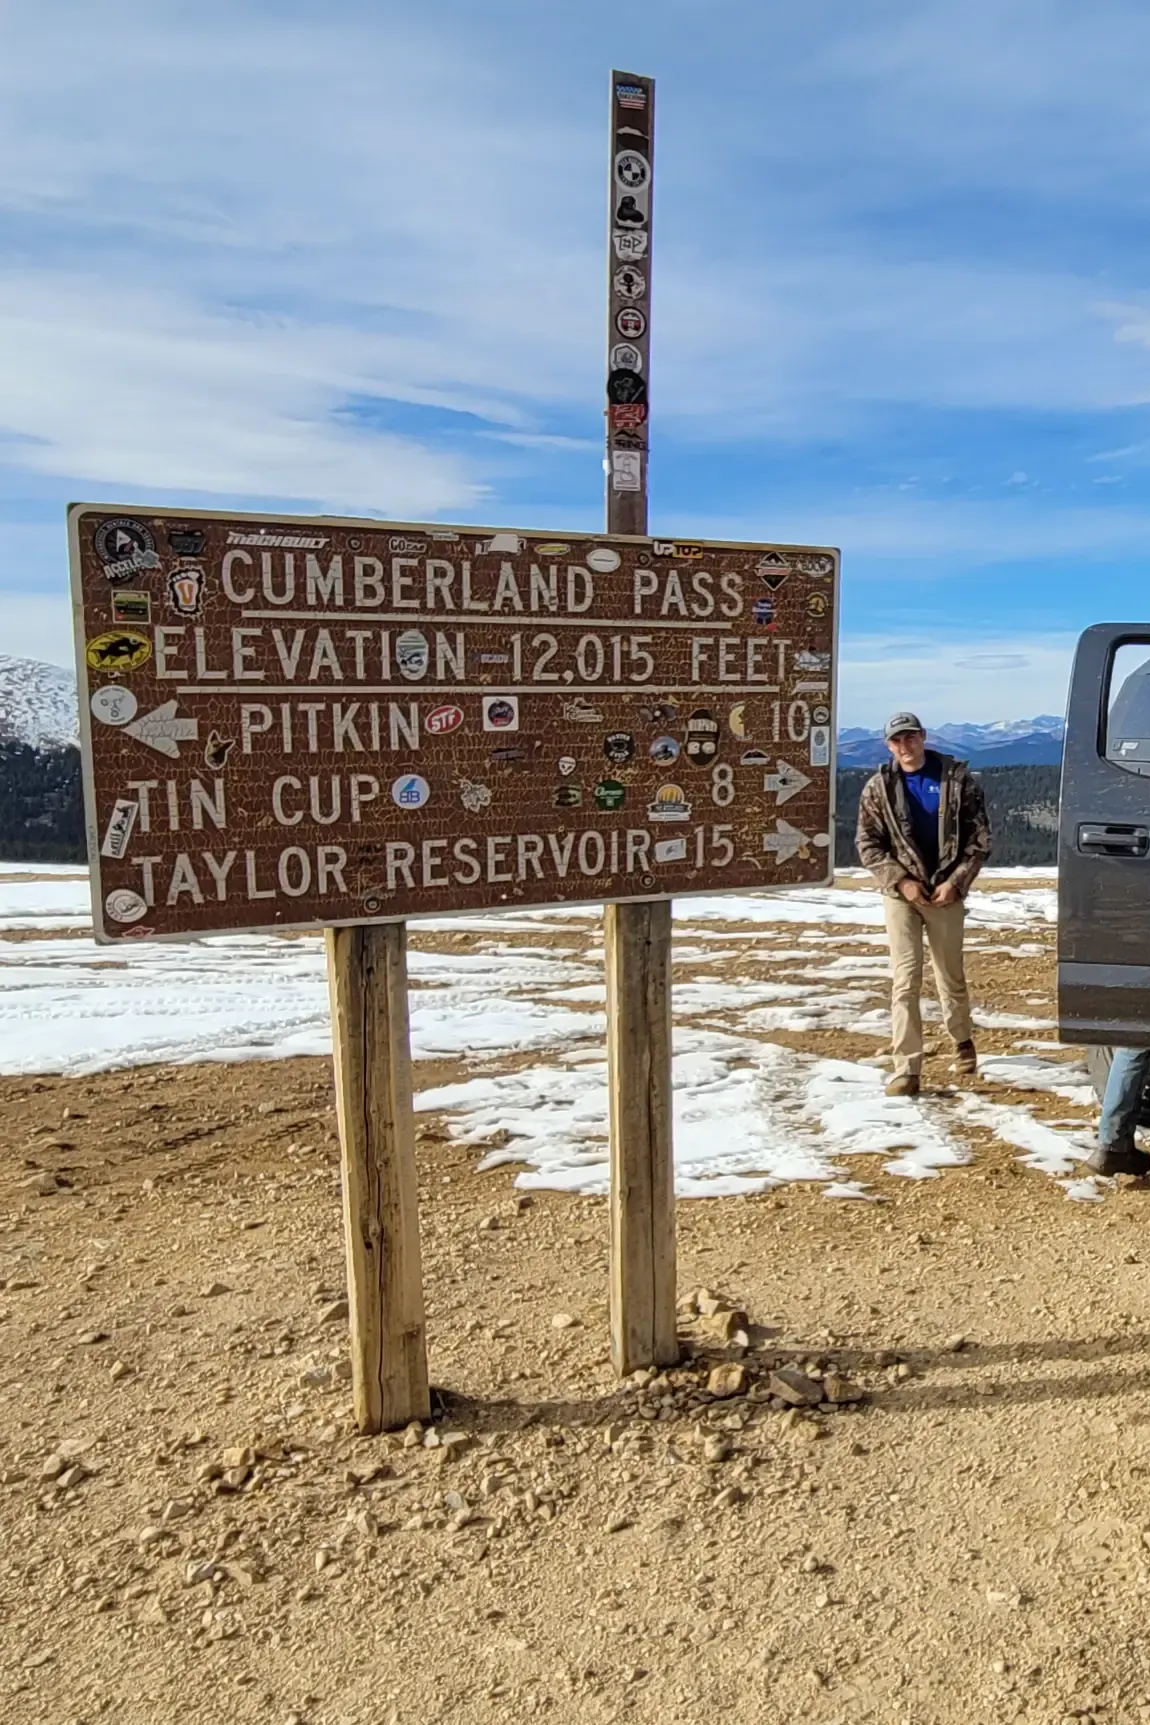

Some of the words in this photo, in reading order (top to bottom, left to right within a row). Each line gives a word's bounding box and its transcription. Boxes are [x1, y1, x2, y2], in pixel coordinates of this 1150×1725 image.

[221, 549, 595, 614] CUMBERLAND
[633, 568, 744, 617] PASS
[154, 626, 466, 681] ELEVATIN
[510, 632, 655, 685] 12,015
[692, 636, 792, 683] FEET
[241, 700, 419, 754] PITKIN
[771, 700, 810, 743] 10
[127, 777, 227, 833] TIN
[272, 774, 380, 826] CUP
[712, 763, 735, 807] 8
[131, 845, 348, 908] TAYLOR
[385, 829, 650, 890] RESERVOIR
[694, 823, 735, 868] 15
